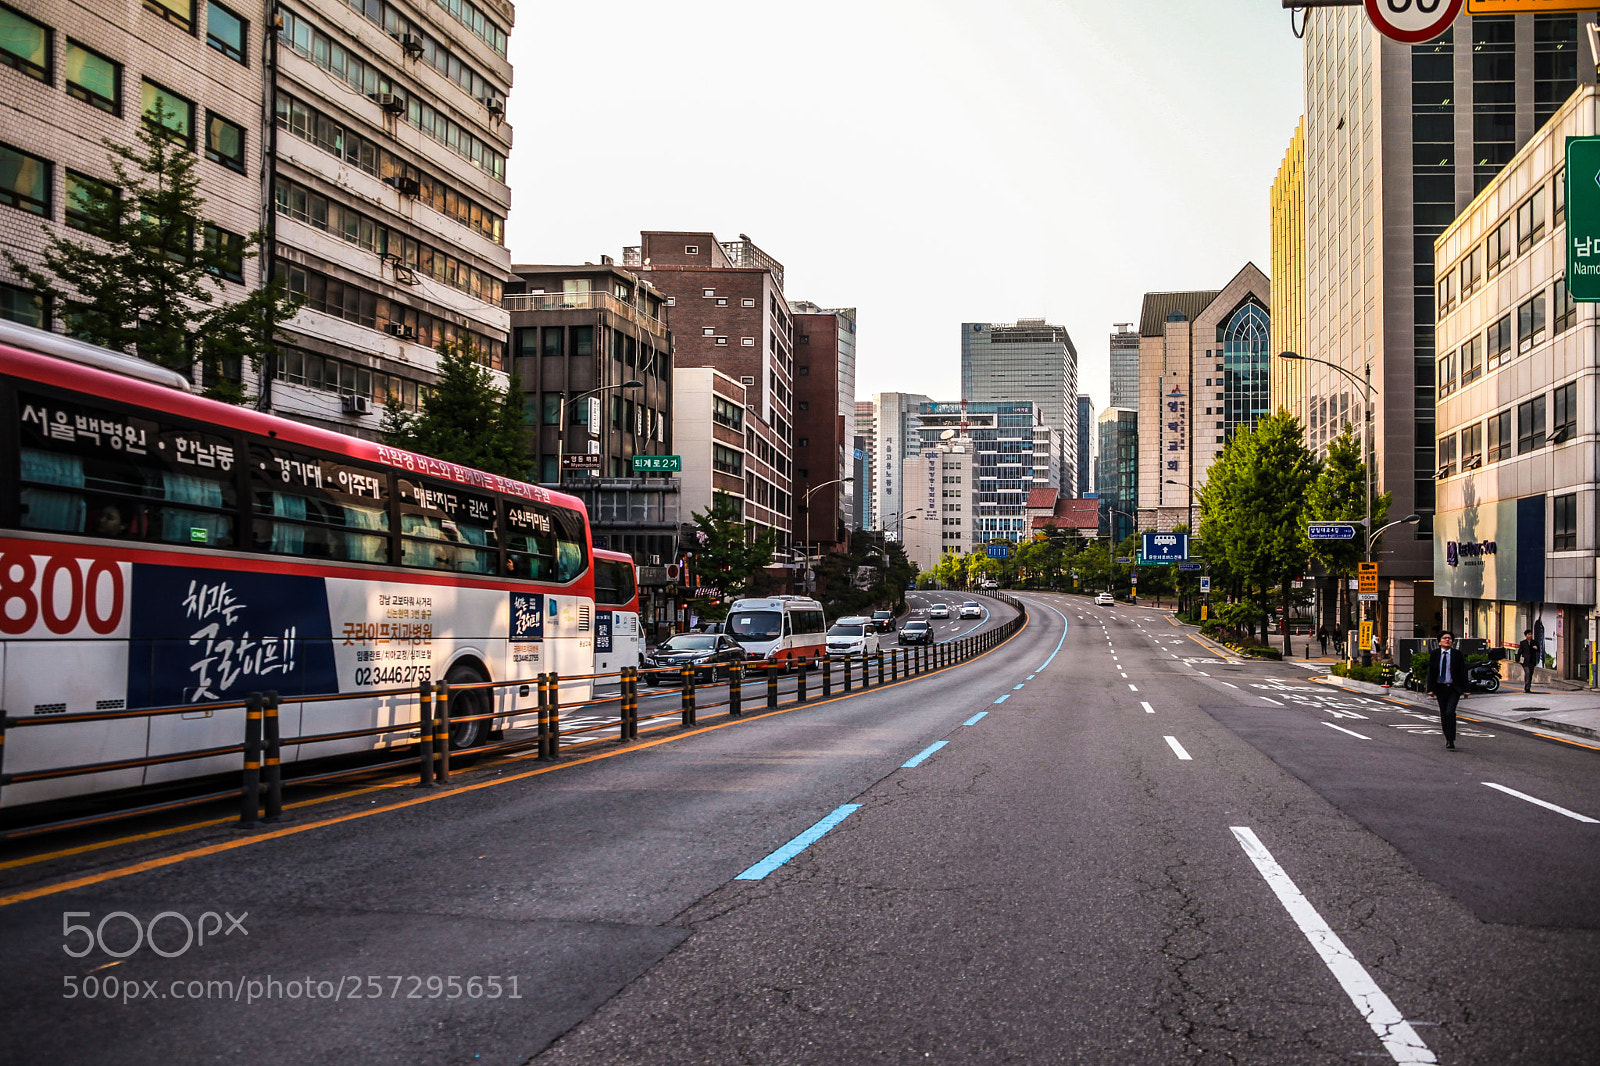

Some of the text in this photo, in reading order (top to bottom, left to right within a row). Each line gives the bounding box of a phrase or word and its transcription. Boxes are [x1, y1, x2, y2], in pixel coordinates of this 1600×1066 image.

[1167, 400, 1179, 472] 영락교회
[21, 404, 550, 533] 서울백병원 한남동 경기대 아주대 매탄지구 권선 수원터미널
[377, 446, 551, 504] 친환경 버스와 함께하는 휴먼도시 수원
[570, 455, 583, 463] 명동
[634, 458, 678, 468] 퇴계로2가
[191, 531, 206, 539] CNG
[182, 579, 247, 626] 치과는
[379, 594, 432, 607] 강남 교보타워 사거리
[342, 622, 432, 646] 굿라이프치과병원
[189, 622, 296, 704] 굿라이프!!
